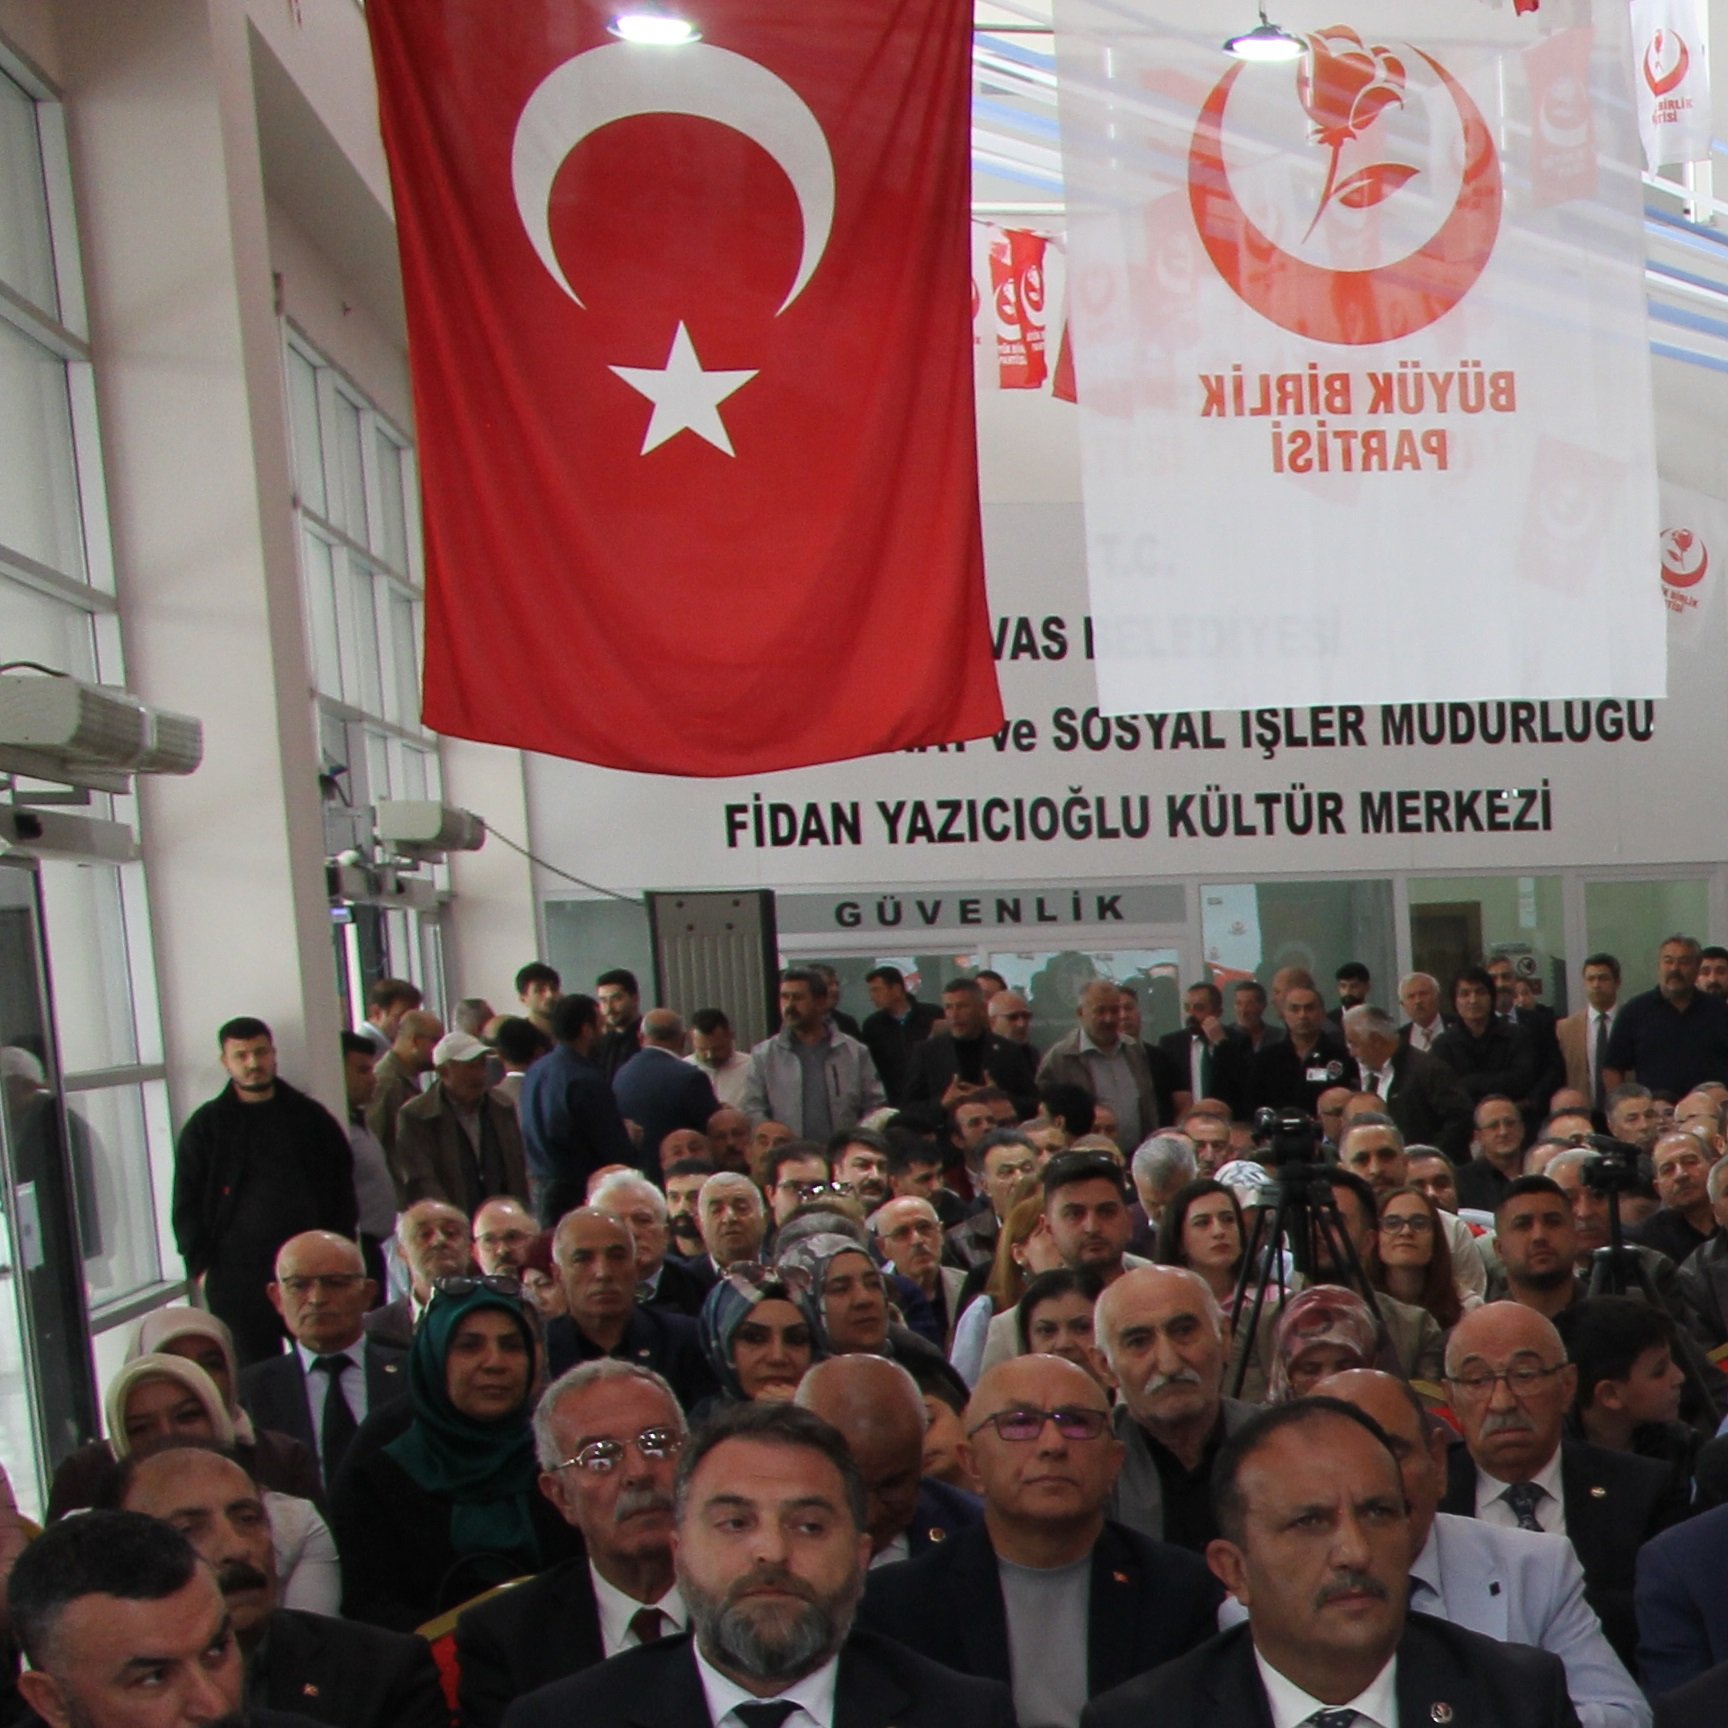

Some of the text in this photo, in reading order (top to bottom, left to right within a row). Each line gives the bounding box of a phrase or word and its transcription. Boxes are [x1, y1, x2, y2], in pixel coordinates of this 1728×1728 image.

[1658, 96, 1694, 111] BİRLİK
[991, 616, 1069, 660] VAS
[1053, 706, 1226, 751] SOSYAL
[724, 778, 1552, 848] FİDAN YAZICIOĞLU KÜLTÜR MERKEZİ
[834, 890, 1124, 928] GÜVENLİK
